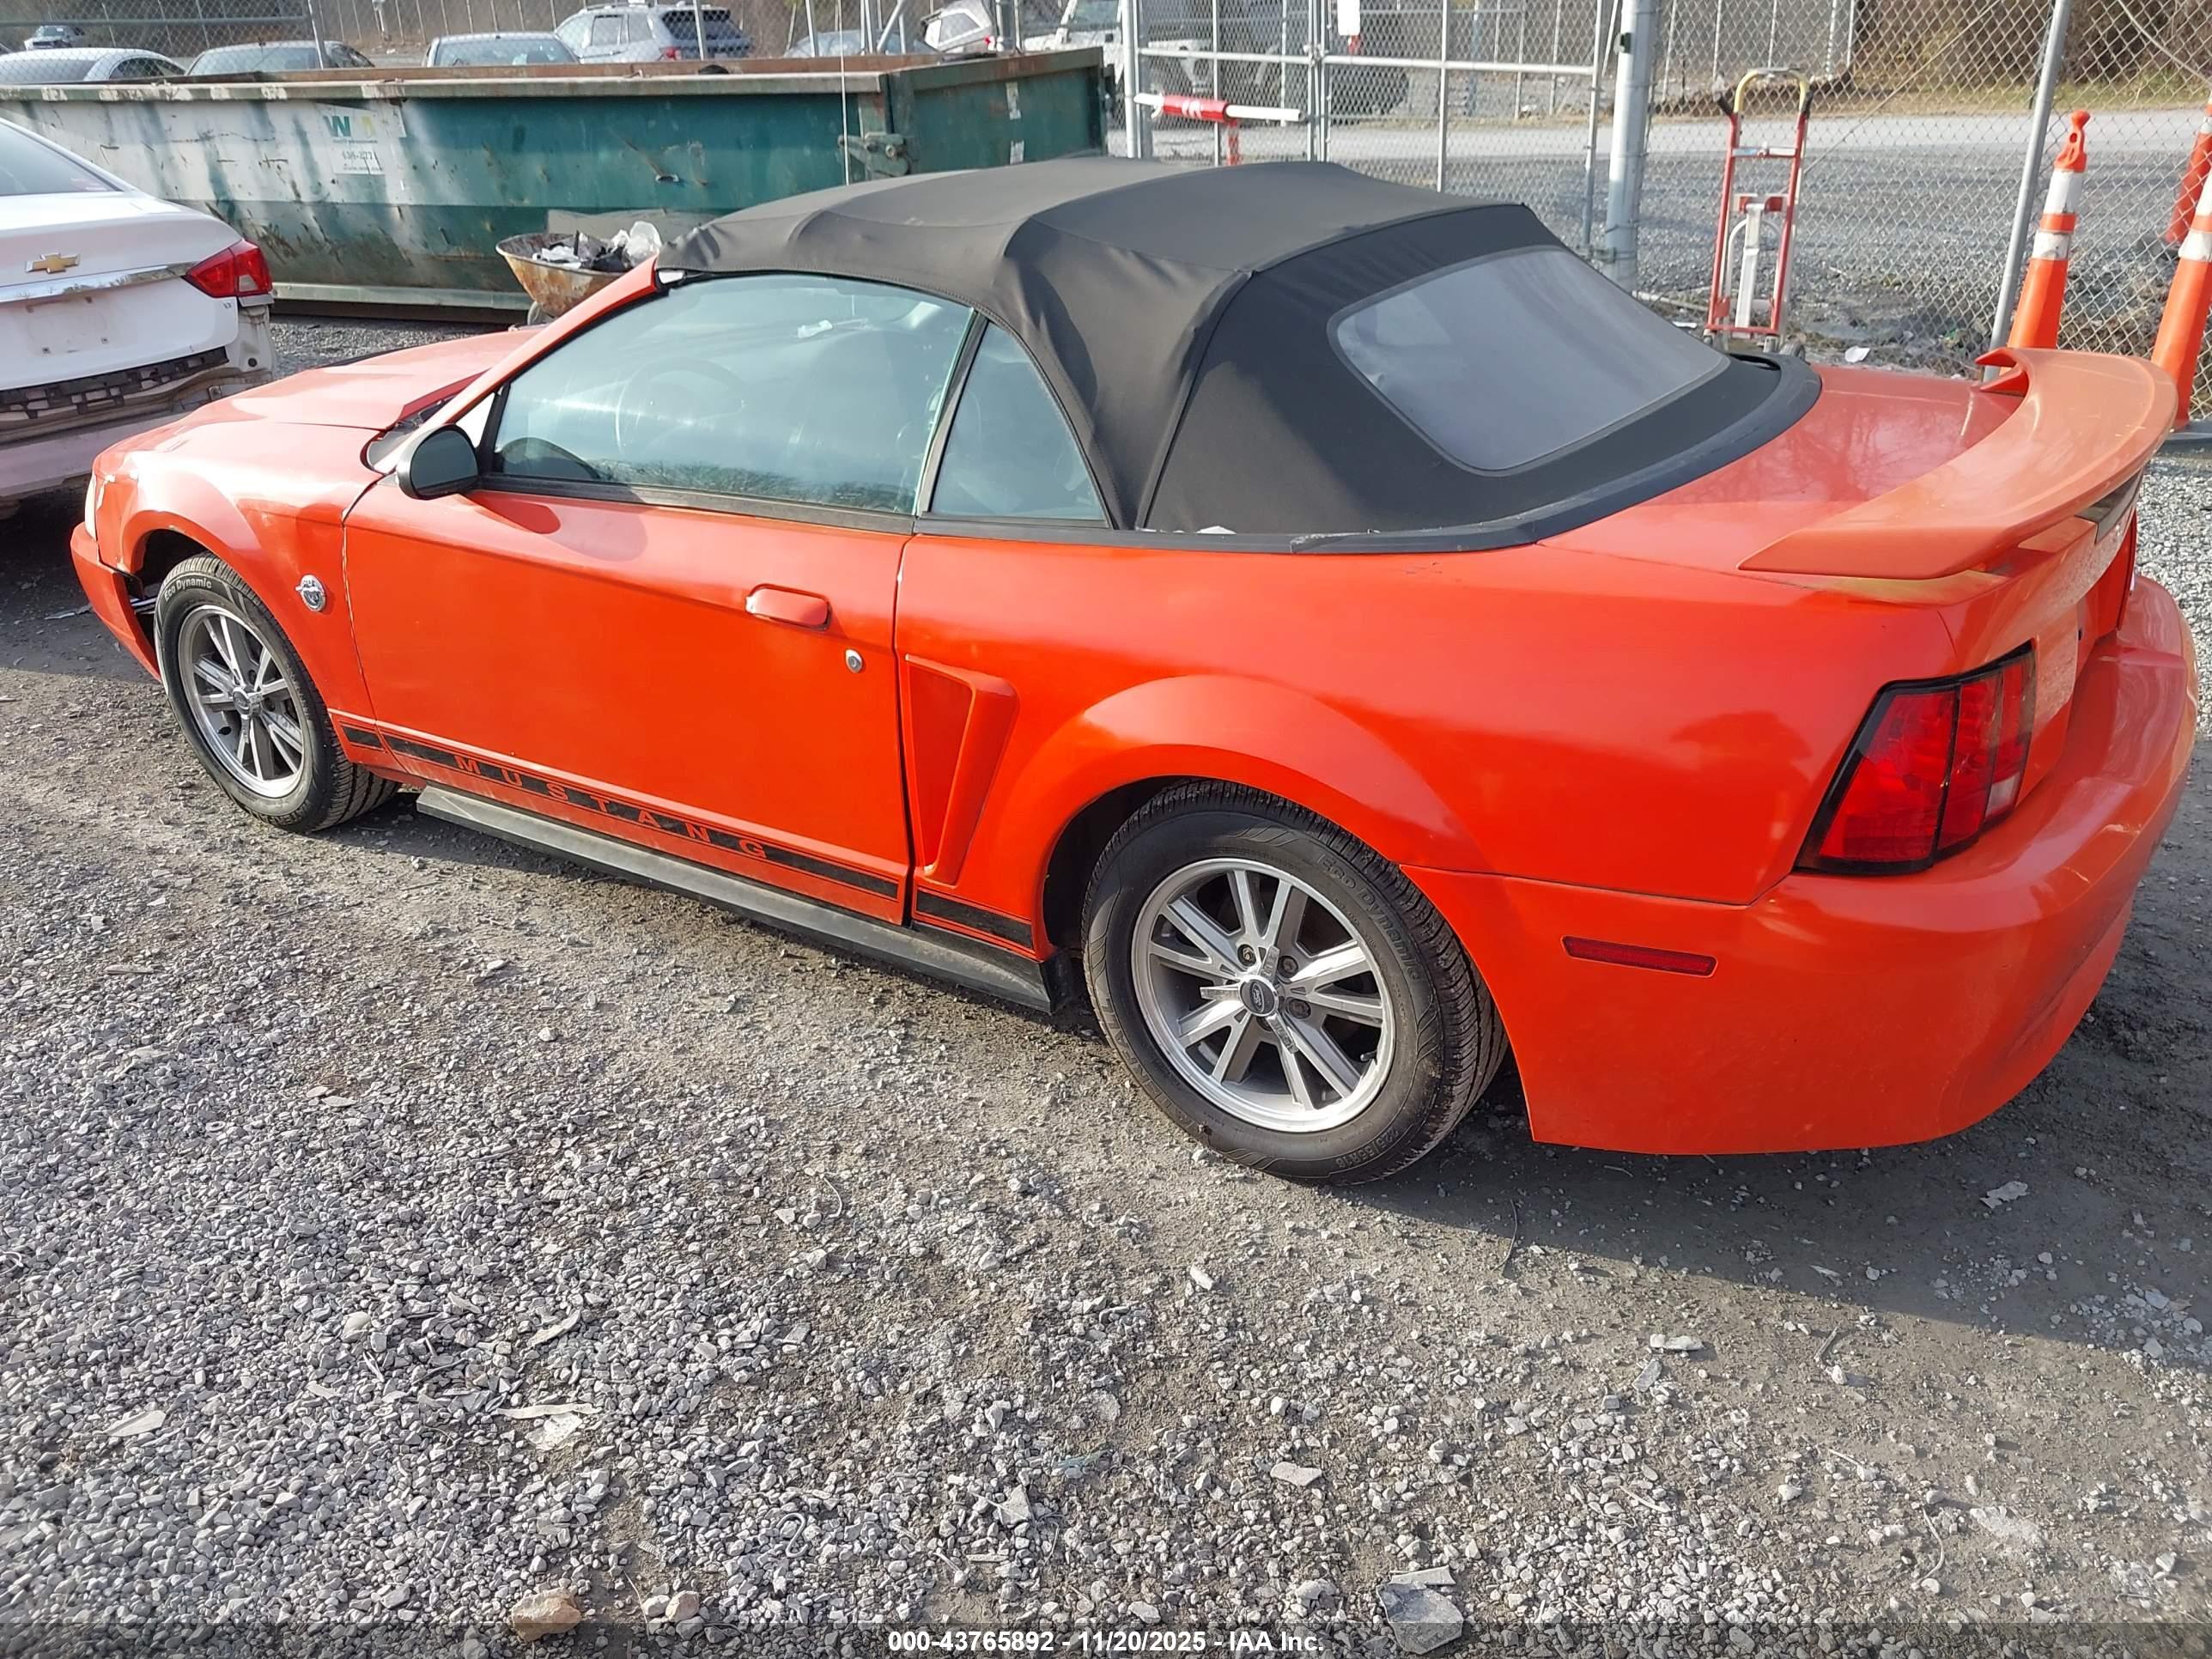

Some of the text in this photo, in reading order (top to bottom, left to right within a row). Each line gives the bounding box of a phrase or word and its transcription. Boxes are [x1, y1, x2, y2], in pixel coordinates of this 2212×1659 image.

[164, 577, 212, 603] Eco Dynamic
[454, 755, 768, 860] MUSTANG
[1316, 853, 1358, 890] Eco
[1356, 887, 1420, 979] Dynamic
